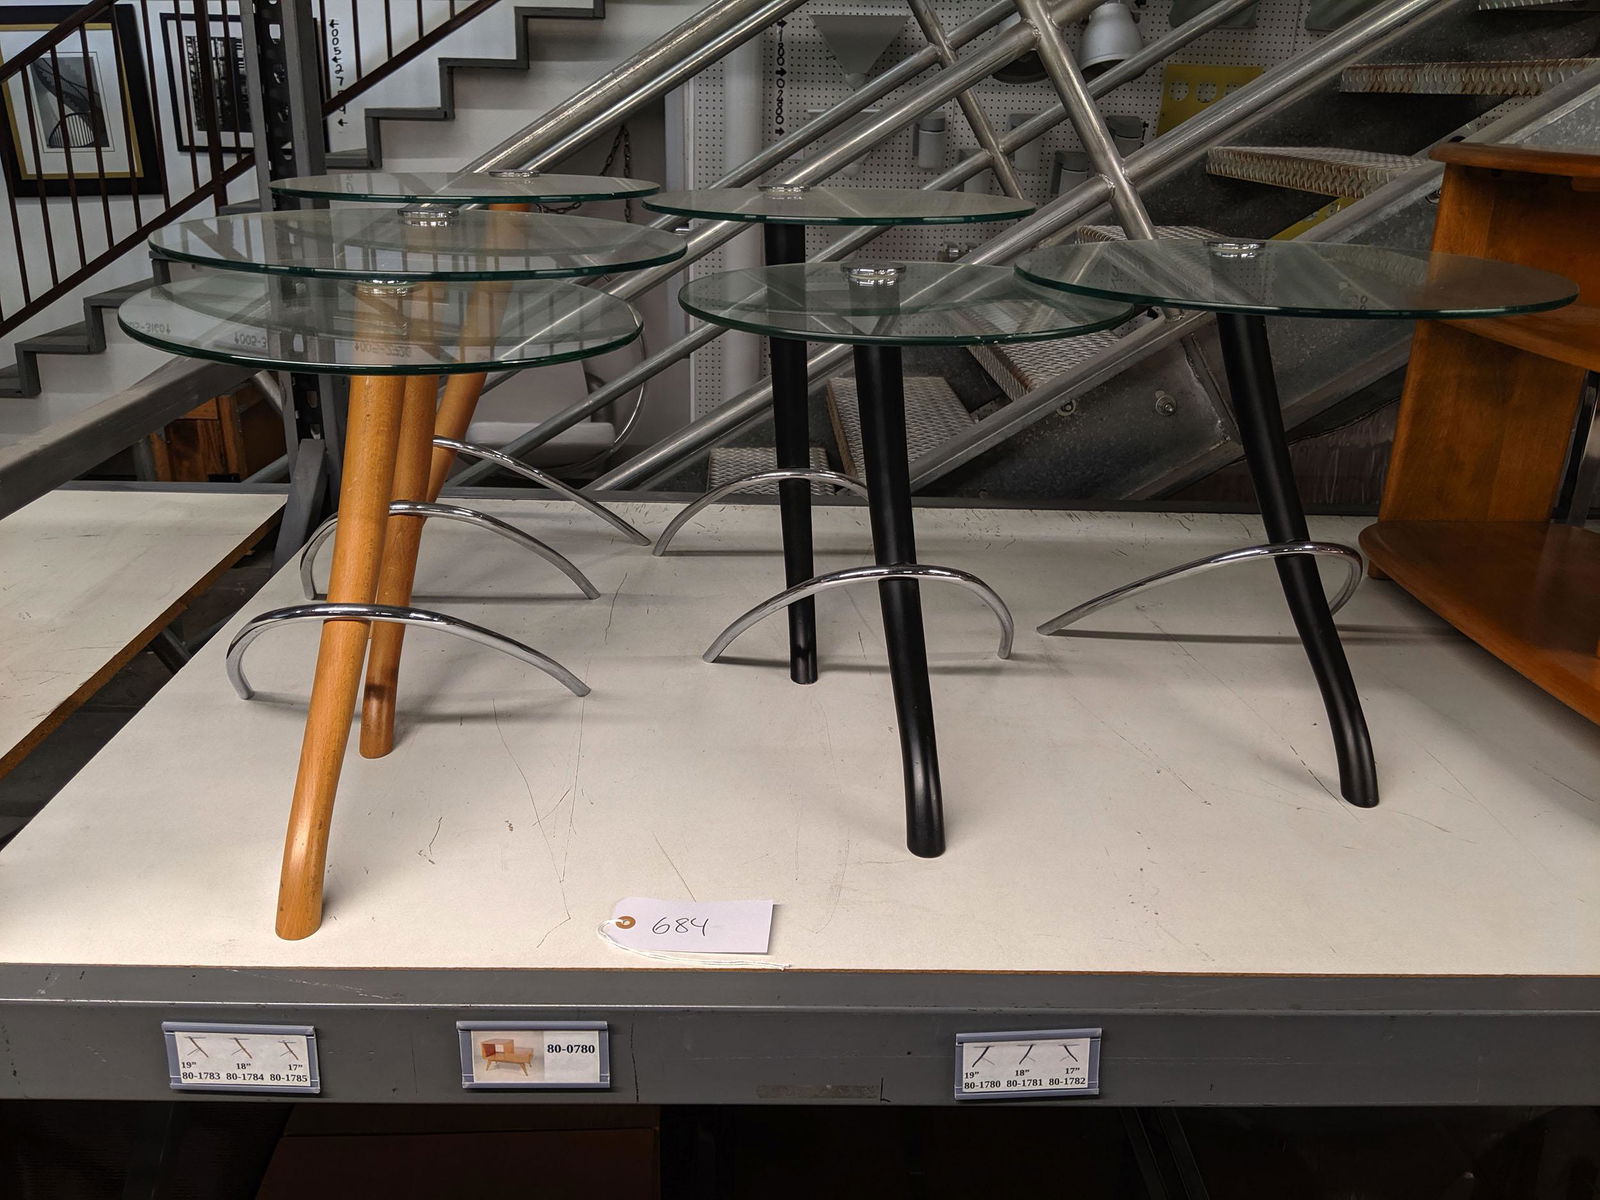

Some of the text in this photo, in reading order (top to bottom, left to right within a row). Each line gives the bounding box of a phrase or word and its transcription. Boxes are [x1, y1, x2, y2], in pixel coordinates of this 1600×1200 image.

[651, 916, 709, 936] 684
[547, 1044, 595, 1053] 80-0780
[182, 1071, 308, 1082] 80-1783 80-1784 80-1785
[964, 1077, 1086, 1090] 80-1780 80-1781 80-1782
